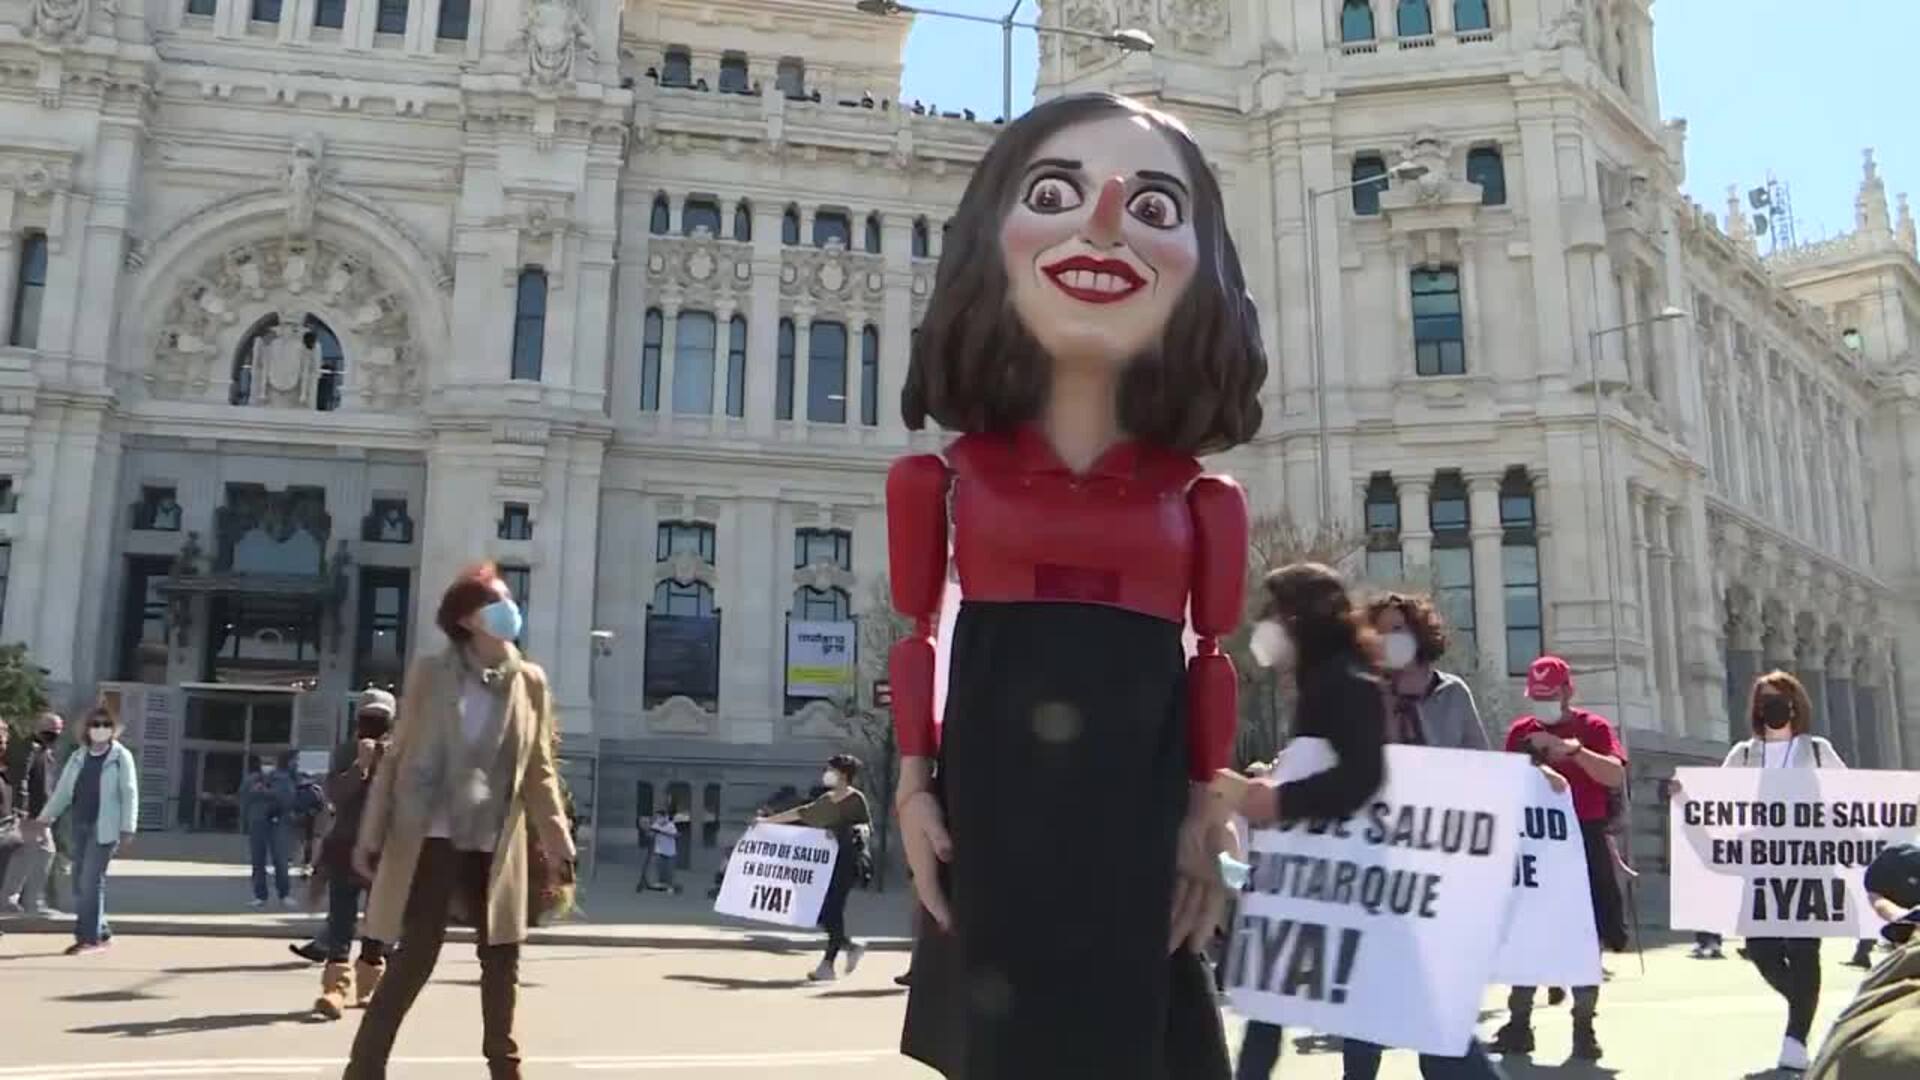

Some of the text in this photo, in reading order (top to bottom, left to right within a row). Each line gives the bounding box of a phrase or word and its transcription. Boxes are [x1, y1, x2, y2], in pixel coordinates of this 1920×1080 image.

[1365, 802, 1495, 857] SALUD
[1518, 806, 1567, 841] UD
[1685, 801, 1917, 829] CENTRO DE SALUD
[737, 840, 831, 864] CENTRO DE SALUD
[1712, 839, 1743, 864] EN
[742, 861, 815, 884] EN BUTARQUE
[750, 884, 793, 914] ¡YA!
[1753, 878, 1846, 922] ¡YA!
[1226, 914, 1363, 1004] ¡YA!
